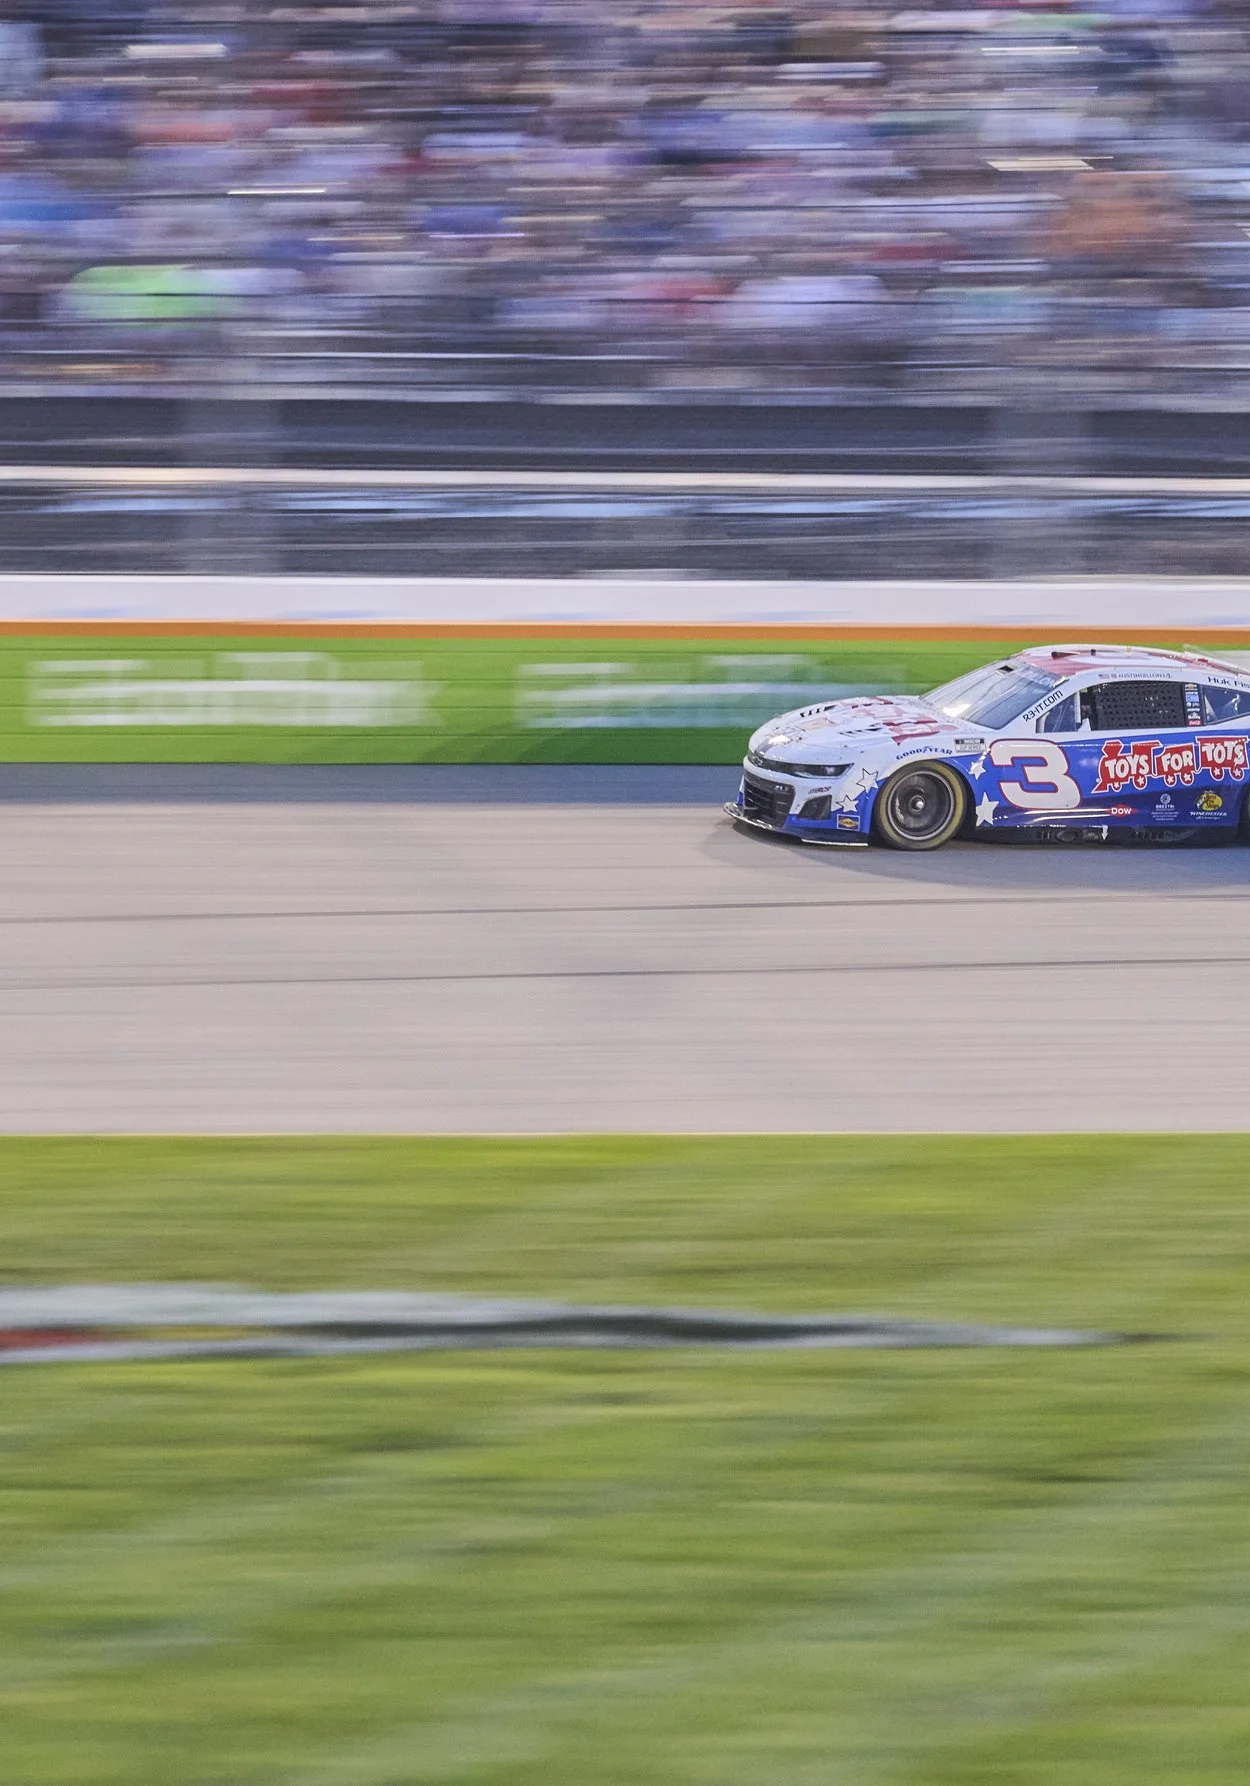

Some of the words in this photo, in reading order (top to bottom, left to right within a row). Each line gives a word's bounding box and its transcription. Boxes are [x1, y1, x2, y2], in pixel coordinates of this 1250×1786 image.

[895, 746, 953, 760] GOODYEAR
[1161, 750, 1194, 772] FOR
[1202, 741, 1245, 765] TOTS
[988, 738, 1083, 811] 3
[1105, 754, 1150, 779] TOYS
